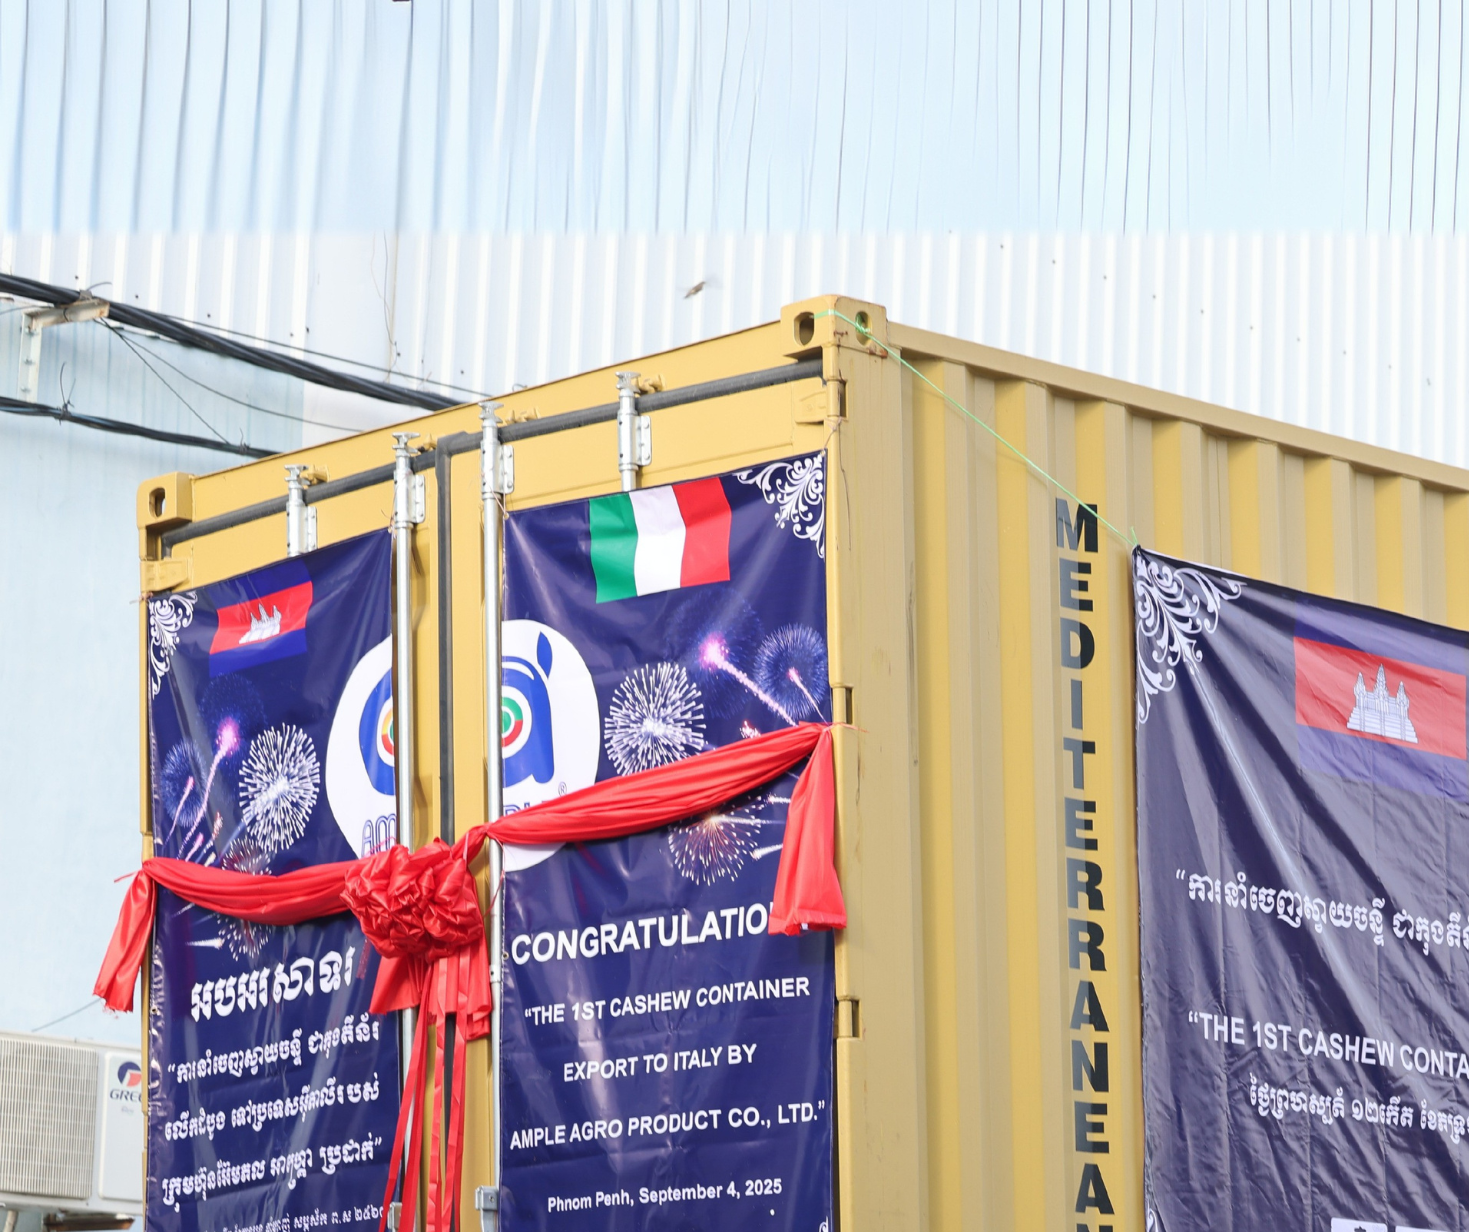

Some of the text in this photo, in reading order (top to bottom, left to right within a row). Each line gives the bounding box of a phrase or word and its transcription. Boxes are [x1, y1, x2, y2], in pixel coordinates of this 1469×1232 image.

[512, 902, 772, 966] CONGRATULATIO
[190, 945, 356, 1022] អបអរសាទរ
[570, 997, 606, 1022] 1ST
[608, 988, 692, 1019] CASHEW
[695, 976, 811, 1009] CONTAINER
[563, 1043, 758, 1084] EXPORT TO ITALY BY
[1188, 1011, 1246, 1046] “THE
[1252, 1020, 1292, 1053] 1ST
[1297, 1027, 1395, 1067] CASHEW
[510, 1099, 826, 1151] AMPLE AGRO PRODUCT CO., LTD.”
[547, 1178, 783, 1214] Phnom Penh, September 4, 2025
